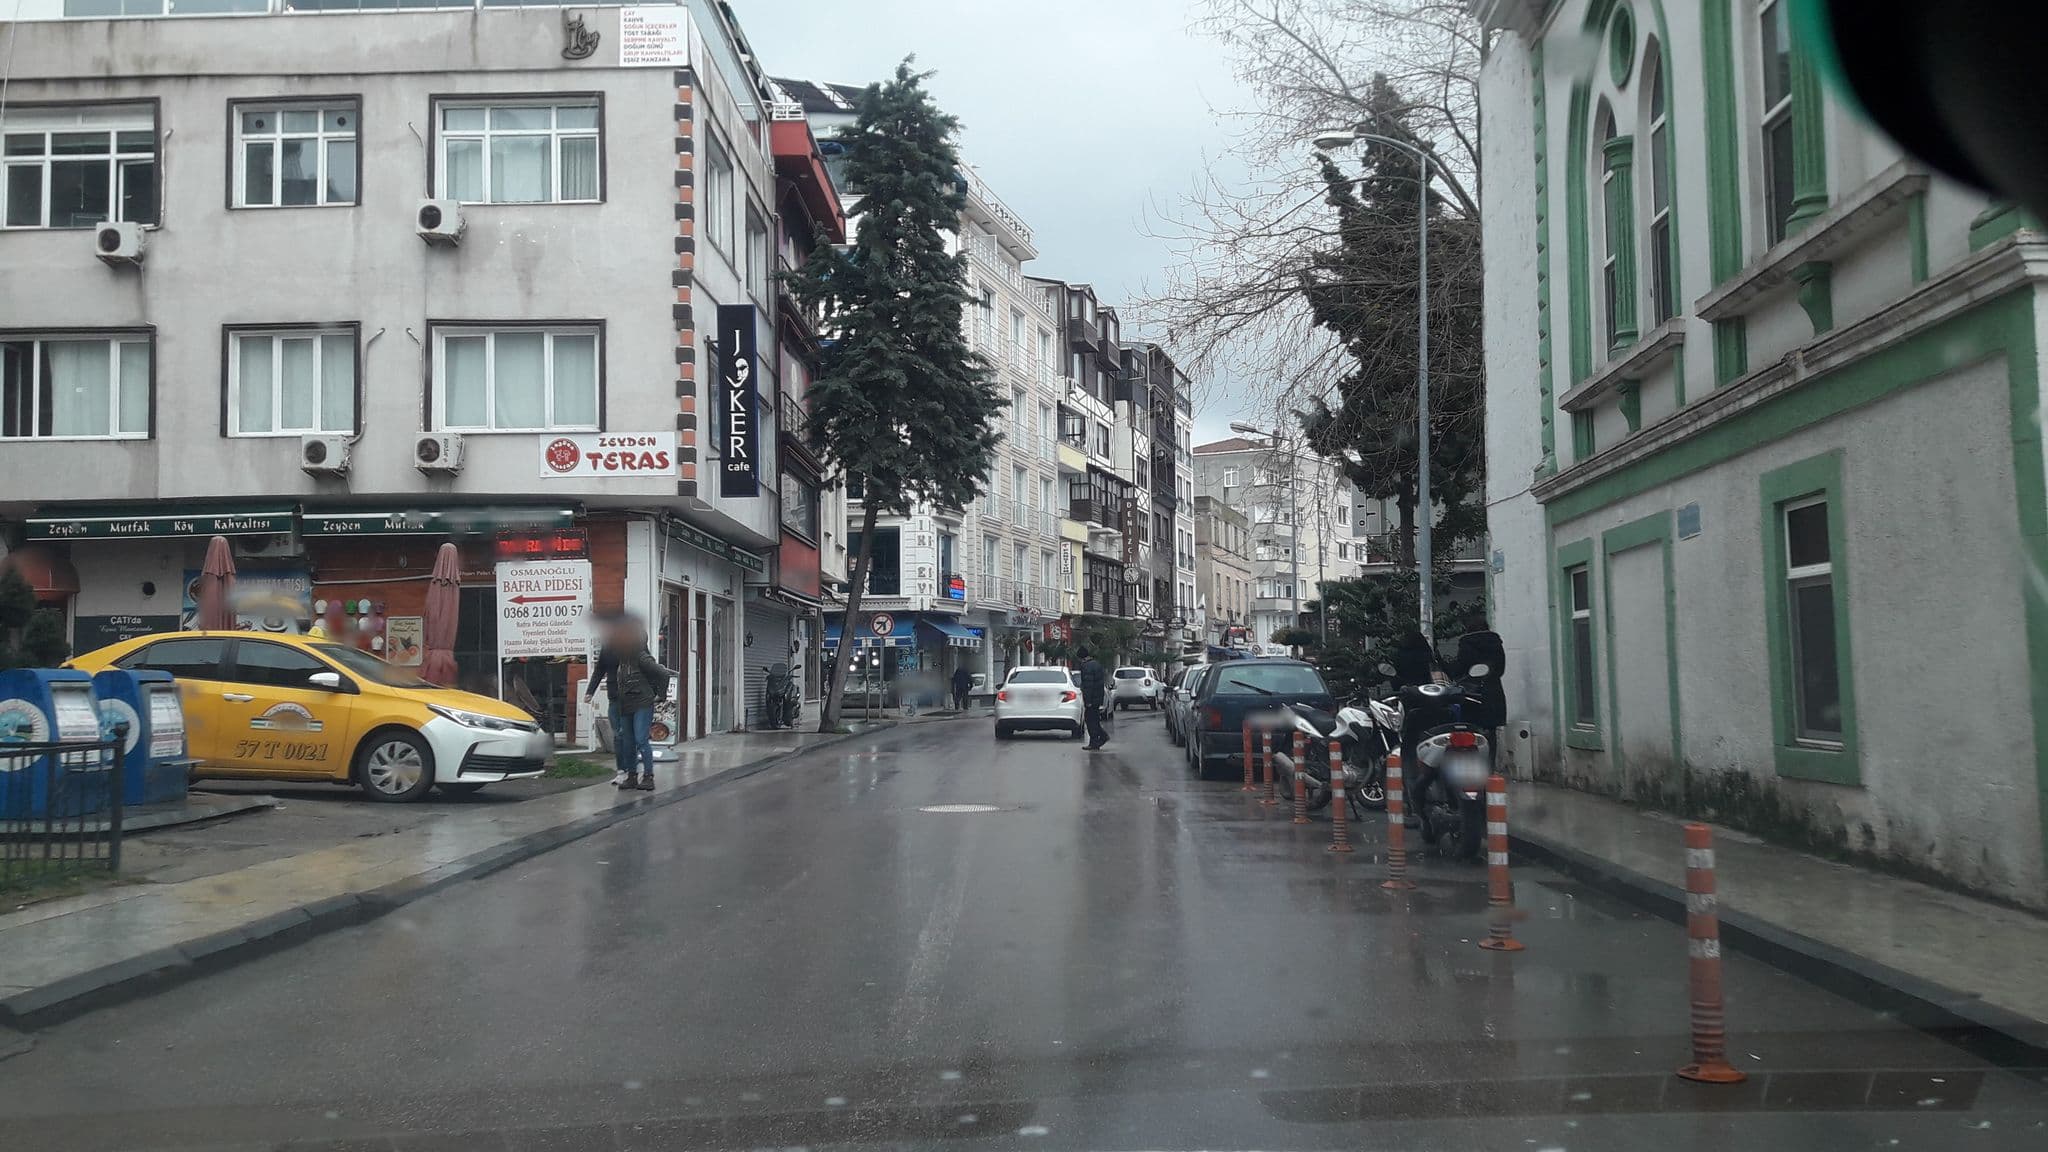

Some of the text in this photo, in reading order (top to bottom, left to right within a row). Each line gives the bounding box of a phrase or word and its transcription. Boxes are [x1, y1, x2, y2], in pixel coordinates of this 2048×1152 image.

[599, 437, 656, 447] ZEYDEN
[586, 451, 669, 470] TERAS
[728, 462, 750, 471] cafe
[110, 522, 150, 533] Mutfak
[174, 521, 194, 533] Köy
[214, 519, 270, 530] Kahvaltısı
[323, 521, 360, 533] Zeyden
[510, 567, 575, 576] OSMANOĞLU
[503, 576, 583, 592] BAFRA PİDESİ
[504, 605, 584, 618] 0368 210 00 57
[236, 740, 328, 761] 57 T 0021
